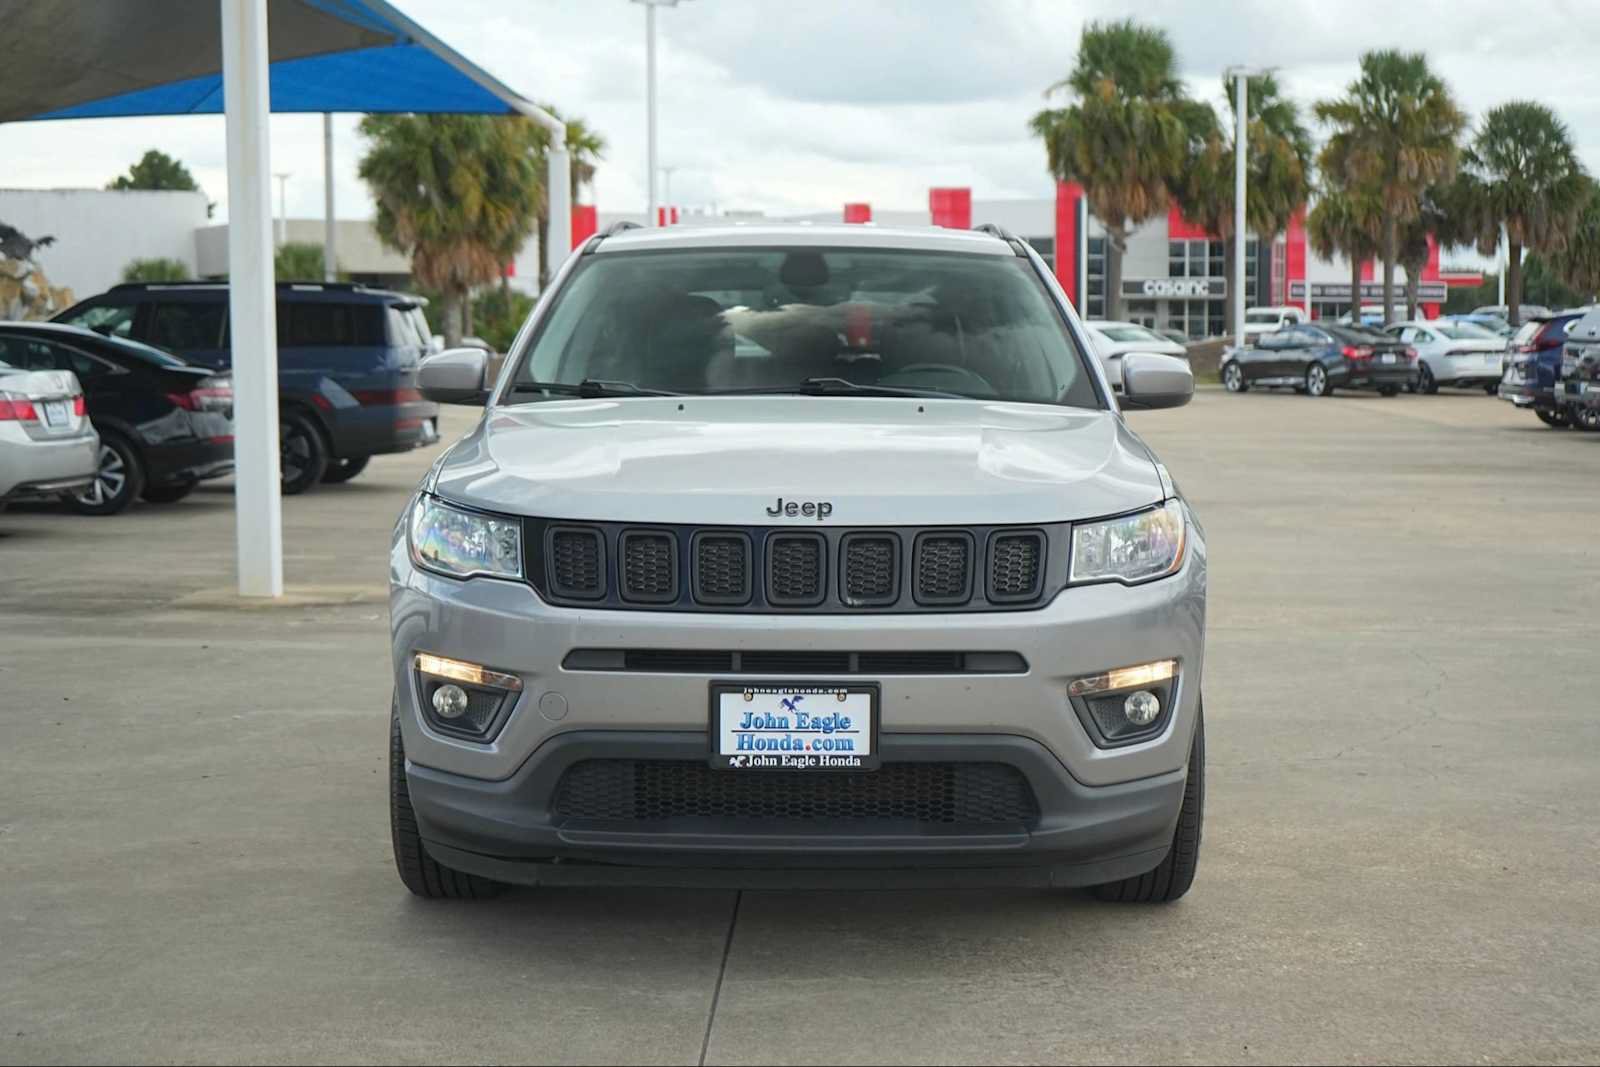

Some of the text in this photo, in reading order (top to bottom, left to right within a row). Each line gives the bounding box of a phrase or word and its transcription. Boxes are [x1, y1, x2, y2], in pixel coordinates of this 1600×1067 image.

[766, 498, 832, 520] Jeep
[740, 712, 851, 733] John Eagle
[736, 734, 854, 751] Honda.com
[747, 756, 861, 768] John Eagle Honda
